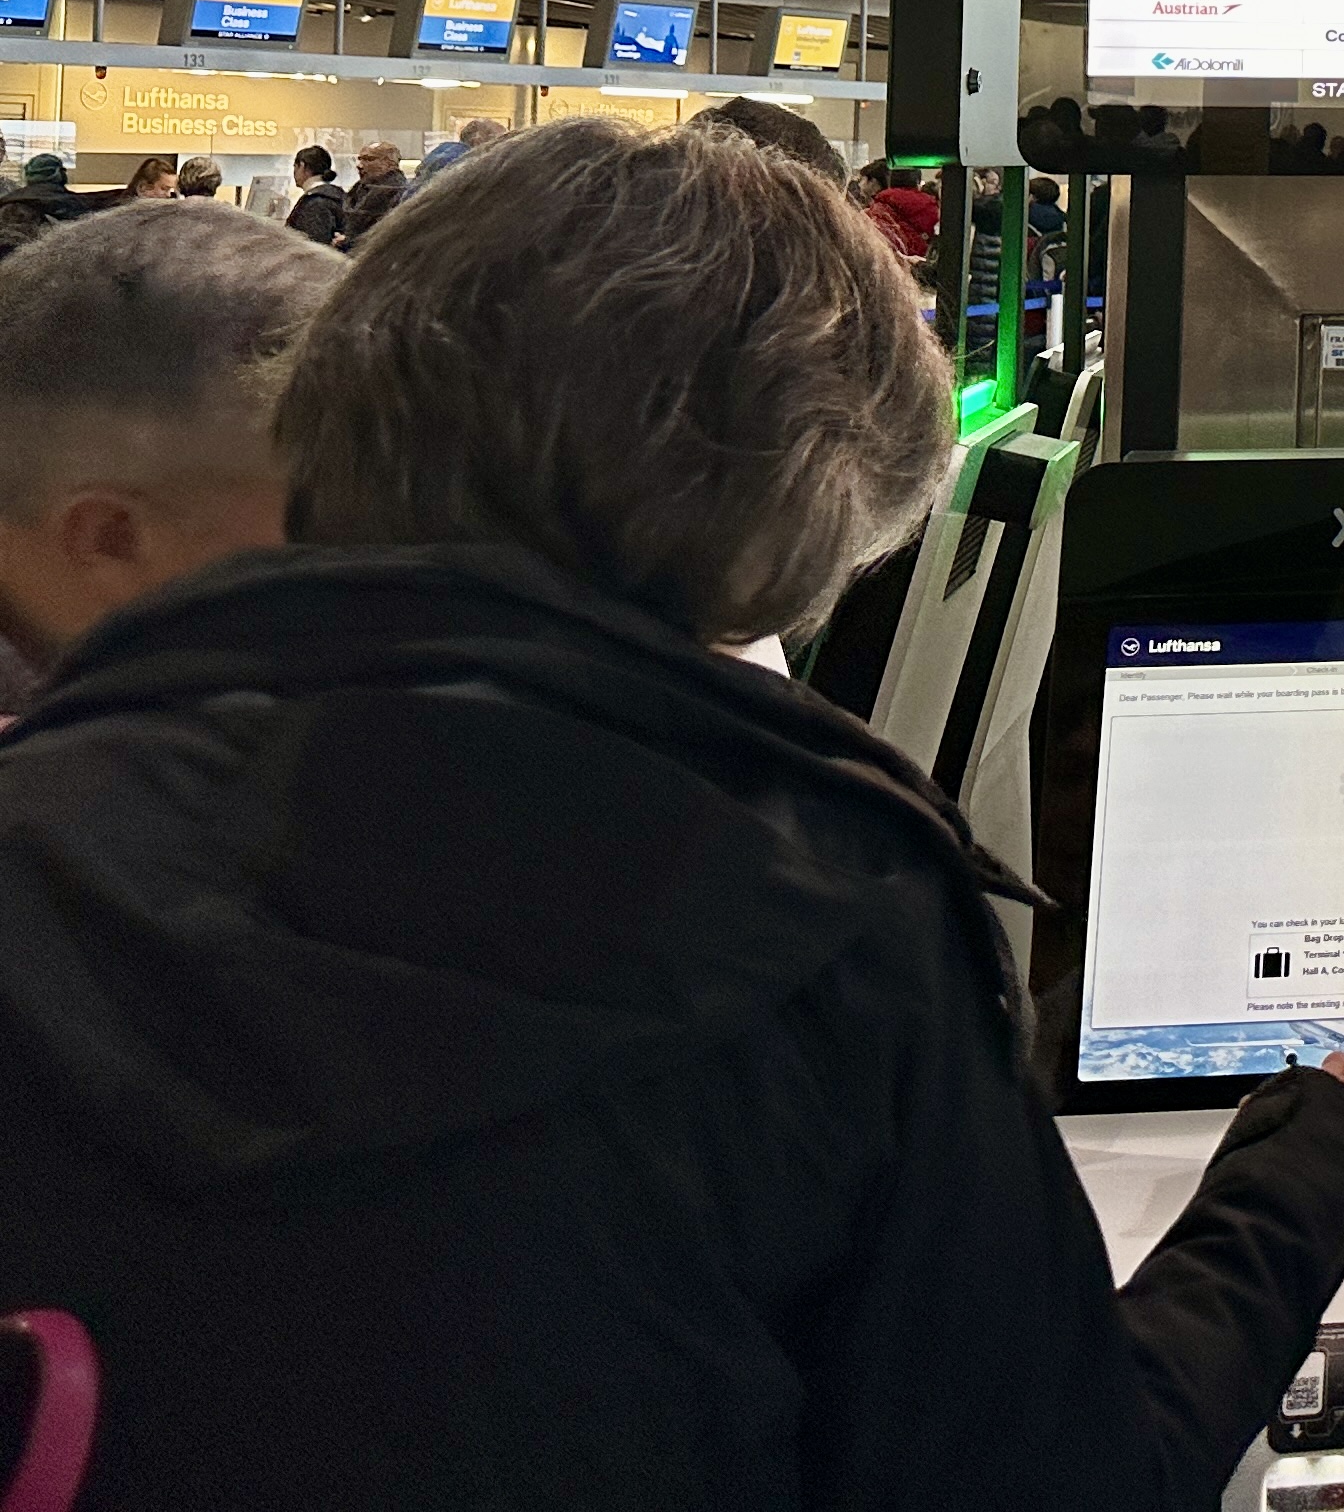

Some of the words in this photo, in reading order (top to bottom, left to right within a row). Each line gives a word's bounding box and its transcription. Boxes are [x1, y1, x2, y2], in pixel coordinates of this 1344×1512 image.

[222, 4, 269, 19] Business
[1152, 0, 1218, 16] Austrian
[221, 15, 251, 29] Class
[183, 53, 205, 68] 133
[122, 85, 229, 111] Lufthansa
[121, 112, 217, 136] Business
[221, 114, 278, 137] Class
[1148, 639, 1221, 654] Lufthansa
[1119, 693, 1138, 702] Dear
[1187, 691, 1214, 700] Please
[1216, 691, 1233, 699] wait
[1235, 690, 1255, 699] while
[1256, 691, 1274, 700] your
[1276, 688, 1310, 699] boarding
[1311, 689, 1330, 698] pass
[1331, 688, 1339, 696] is
[1251, 920, 1267, 929] You
[1286, 918, 1309, 928] check
[1311, 918, 1318, 926] in
[1320, 918, 1338, 928] your
[1304, 934, 1321, 944] Bag
[1323, 933, 1344, 943] Drop
[1304, 949, 1341, 959] Terminal
[1302, 966, 1319, 975] Hall
[1246, 1002, 1275, 1012] Please
[1276, 1002, 1294, 1010] note
[1296, 1000, 1309, 1009] the
[1310, 999, 1341, 1010] existing
